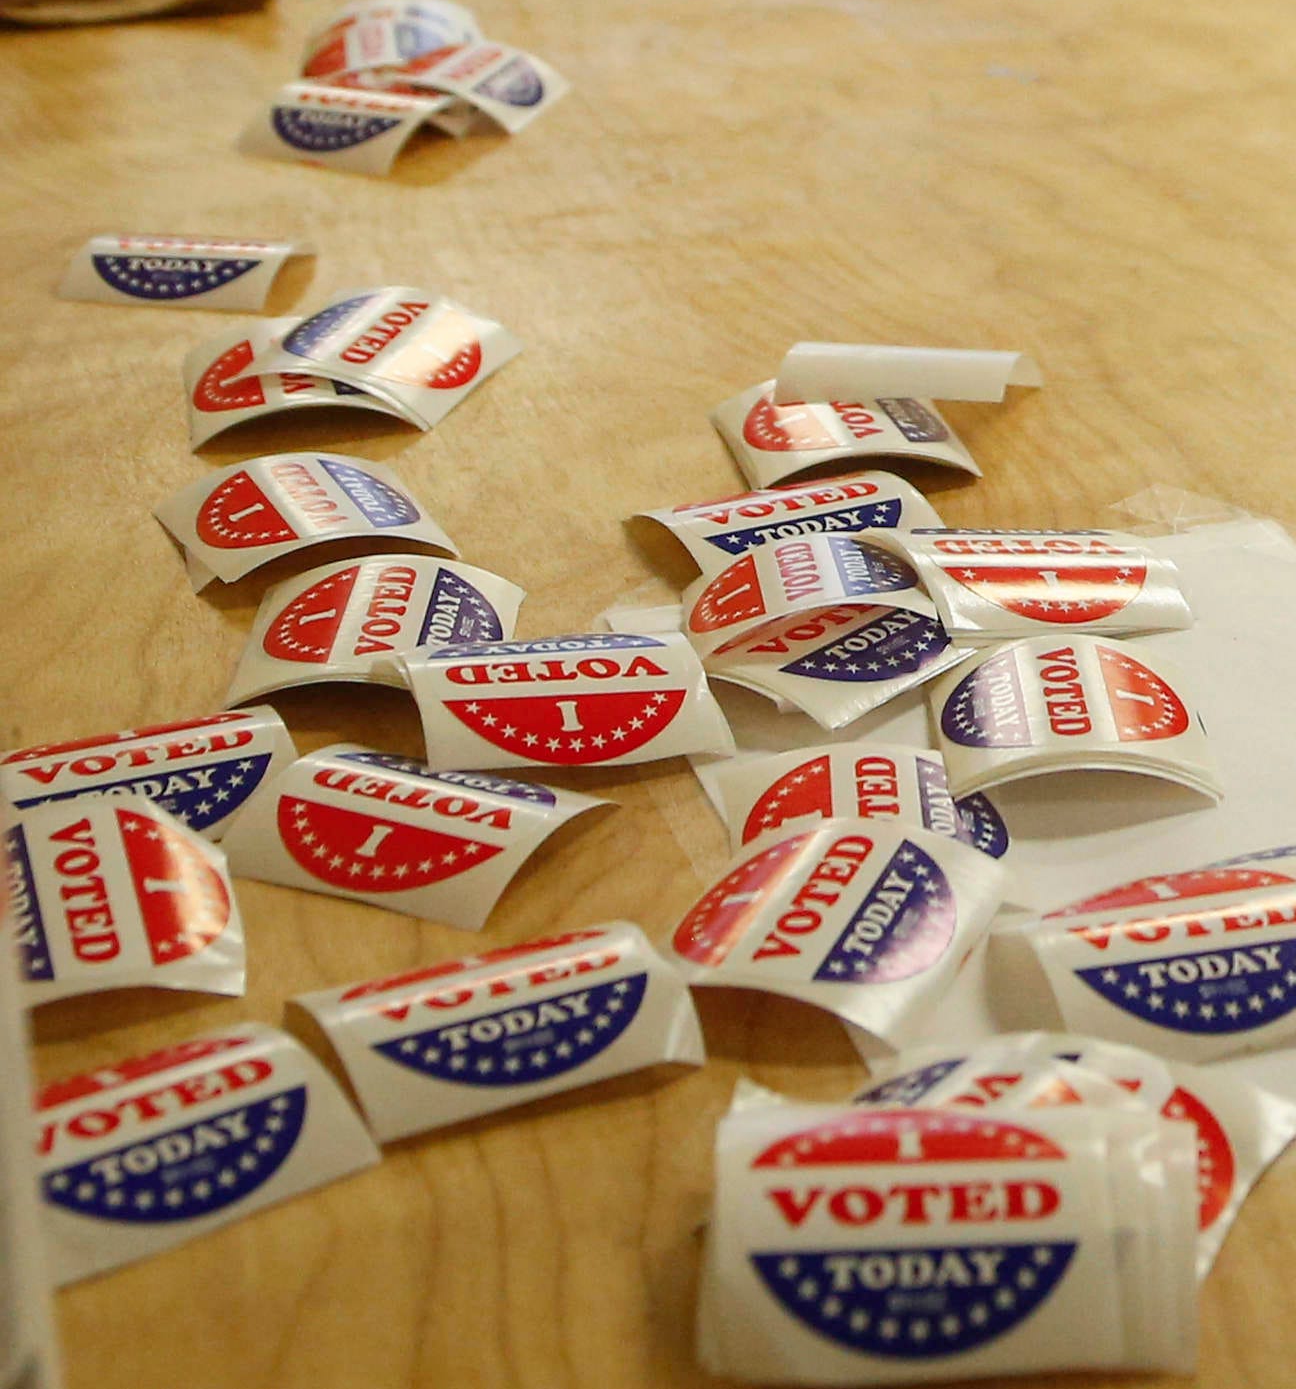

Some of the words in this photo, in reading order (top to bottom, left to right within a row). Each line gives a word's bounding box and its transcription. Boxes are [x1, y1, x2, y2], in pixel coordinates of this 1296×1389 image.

[340, 300, 430, 364] VOTED
[829, 400, 885, 439] VOT
[228, 502, 265, 522] I
[271, 463, 349, 529] VOTED
[335, 472, 387, 513] TODAY
[698, 481, 880, 525] VOTED
[754, 510, 864, 543] TODAY
[932, 539, 1127, 556] VOTED
[774, 542, 824, 602] VOTED
[838, 546, 873, 582] TODAY
[300, 608, 338, 626] I
[353, 565, 418, 656] VOTED
[424, 589, 463, 647] TODAY
[716, 583, 752, 606] I
[483, 639, 614, 656] TODAY
[746, 604, 881, 654] VOT
[824, 610, 922, 662] TODAY
[445, 655, 670, 686] VOTED
[1036, 646, 1093, 736] VOTED
[555, 699, 585, 732] I
[987, 671, 1022, 728] TODAY
[1114, 688, 1155, 706] I
[17, 729, 255, 785] VOTED
[312, 768, 512, 830] VOTED
[855, 755, 901, 819] TED
[929, 781, 959, 836] ODAY
[354, 823, 394, 858] I
[47, 817, 123, 963] VOTED
[143, 878, 190, 896] I
[719, 888, 764, 908] I
[752, 834, 875, 961] VOTED
[1151, 882, 1182, 900] I
[841, 869, 915, 956] TODAY
[378, 948, 622, 1024] VOTED
[1138, 945, 1285, 989] TODAY
[438, 991, 593, 1052] TODAY
[89, 1109, 251, 1187] TODAY
[898, 1123, 924, 1161] I
[766, 1178, 1063, 1231] VOTED
[822, 1248, 1004, 1293] TODAY
